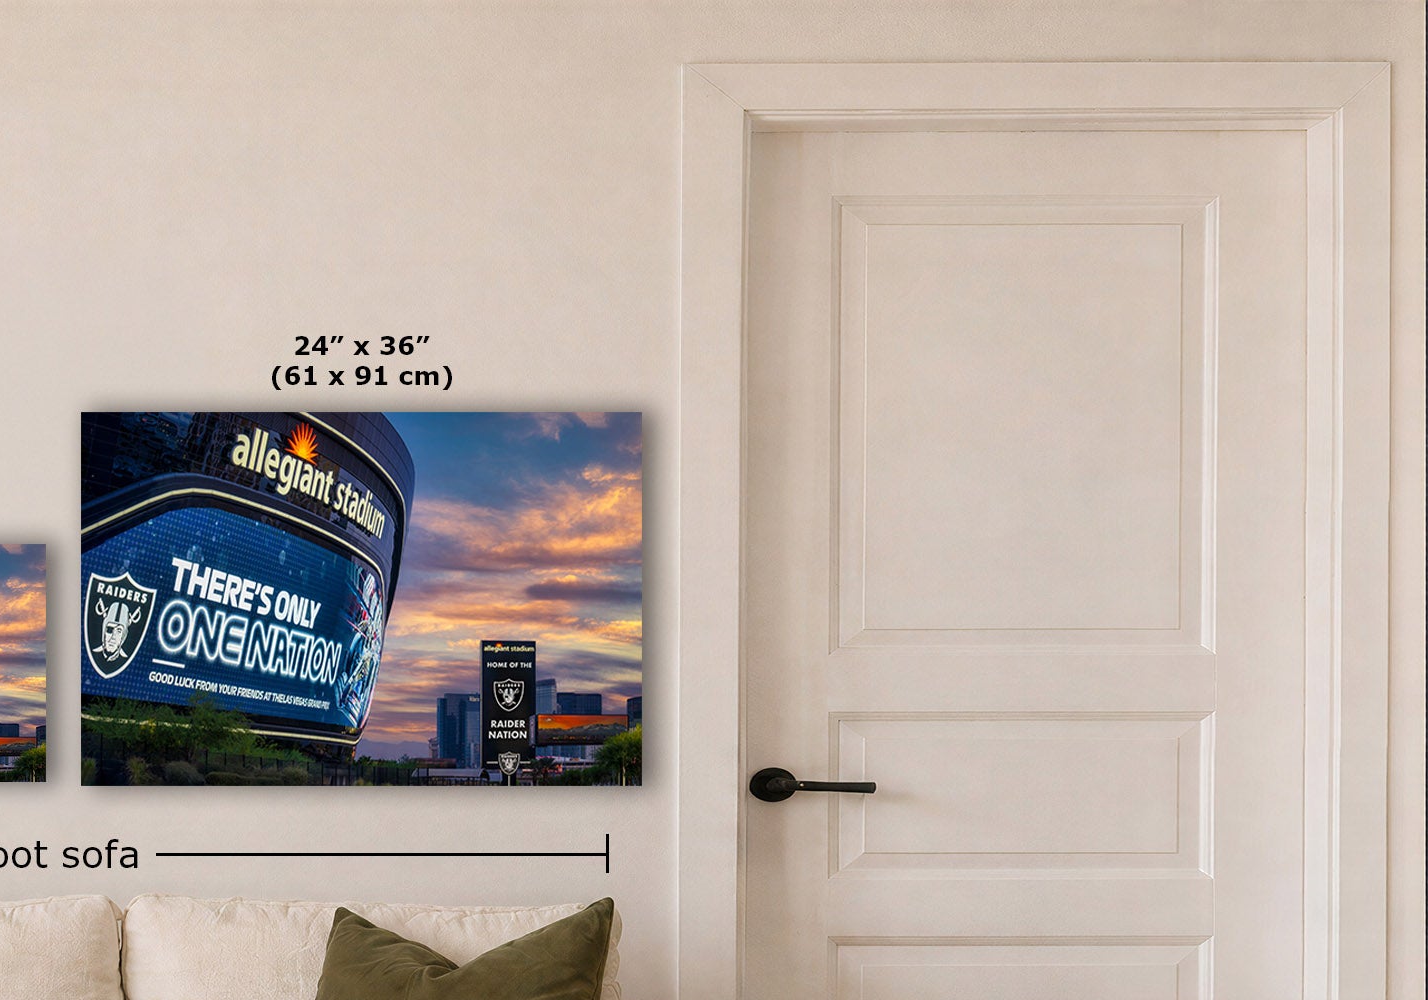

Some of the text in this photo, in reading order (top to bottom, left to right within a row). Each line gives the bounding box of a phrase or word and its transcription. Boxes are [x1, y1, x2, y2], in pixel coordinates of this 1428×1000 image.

[232, 428, 385, 539] allegiant stadium
[97, 582, 148, 604] RAIDERS
[172, 557, 321, 629] THERE'S ONLY
[159, 600, 342, 685] ONE NATION
[148, 672, 174, 685] GOOD
[174, 676, 195, 689] LUCK
[196, 680, 218, 692] FROM
[218, 684, 237, 696] YOUR
[237, 687, 264, 700] FRIENDS
[264, 692, 271, 701] AT
[488, 731, 527, 739] NATION
[491, 720, 526, 728] RAIDER
